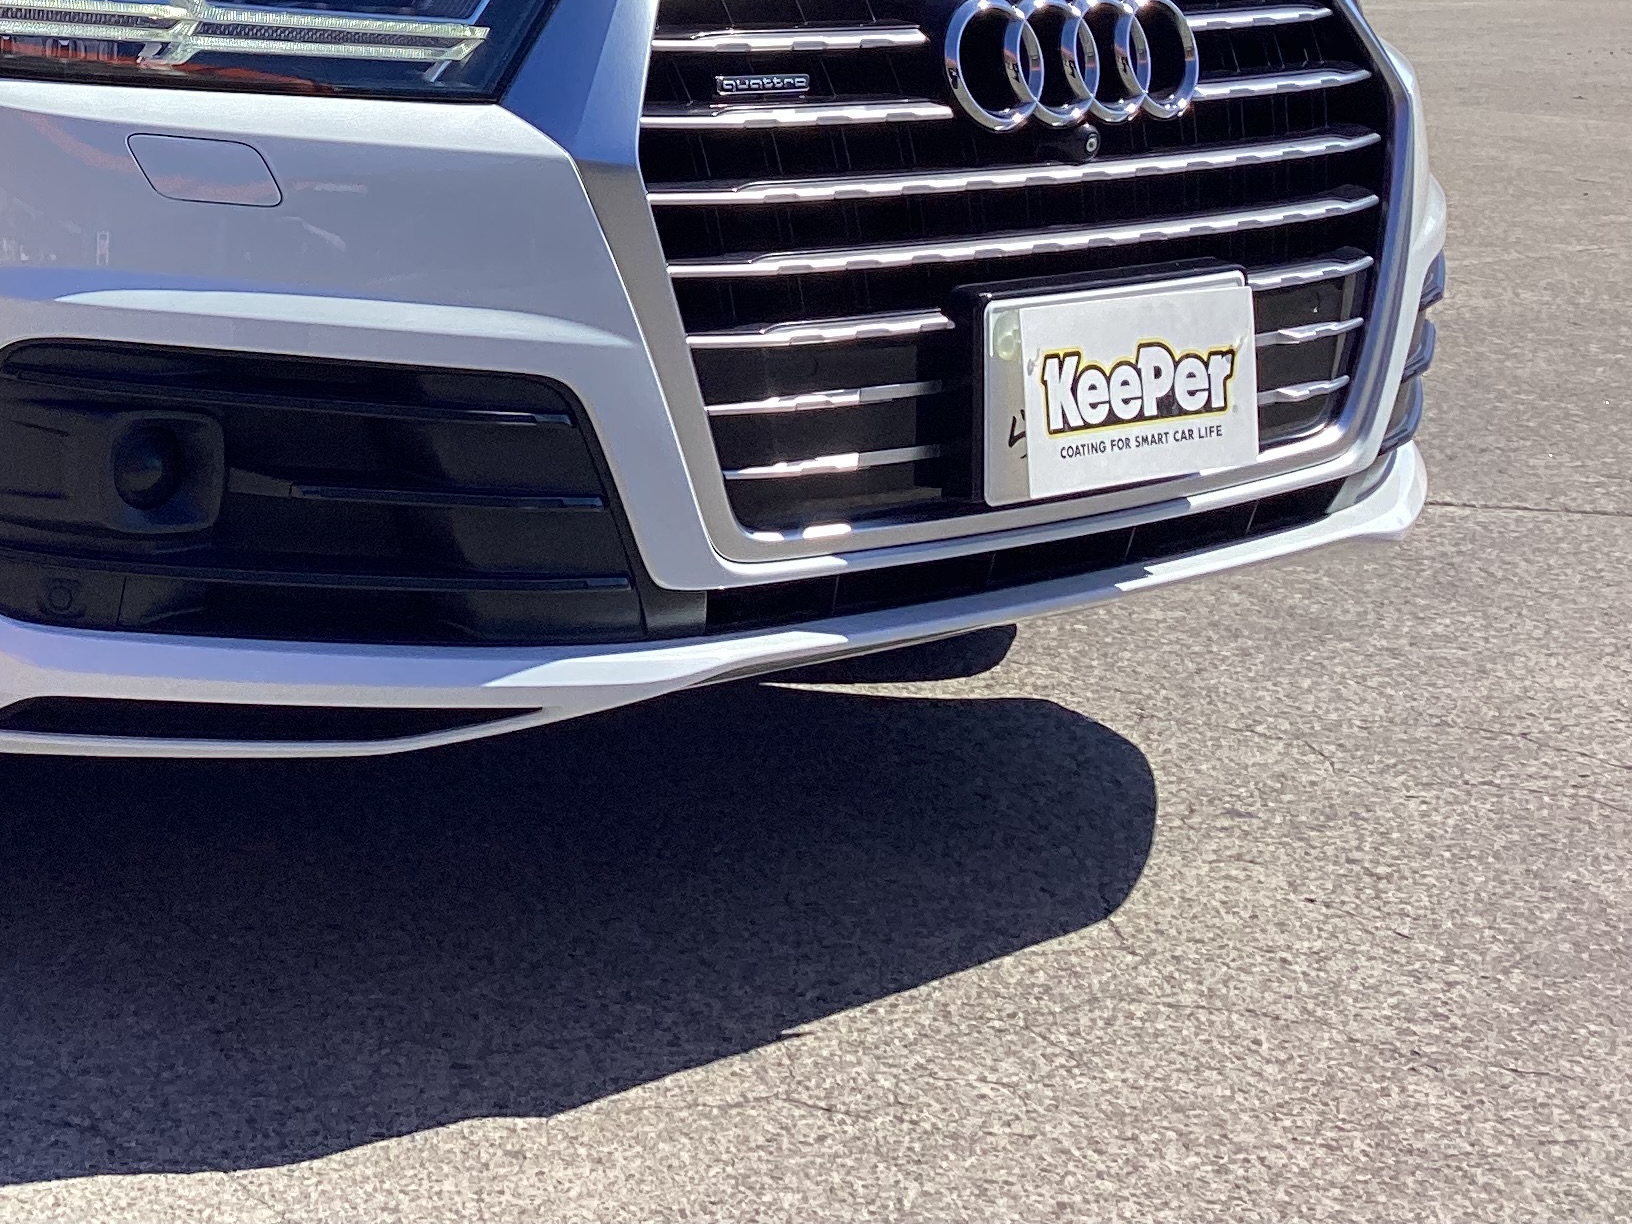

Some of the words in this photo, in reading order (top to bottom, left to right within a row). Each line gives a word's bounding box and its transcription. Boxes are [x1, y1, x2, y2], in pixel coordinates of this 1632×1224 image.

[722, 77, 807, 92] quattro
[1043, 343, 1234, 433] KeePer
[1060, 440, 1107, 459] COATING
[1110, 437, 1132, 452] FOR
[1135, 432, 1170, 450] SMART
[1173, 429, 1195, 442] CAR
[1198, 425, 1223, 439] LIFE
